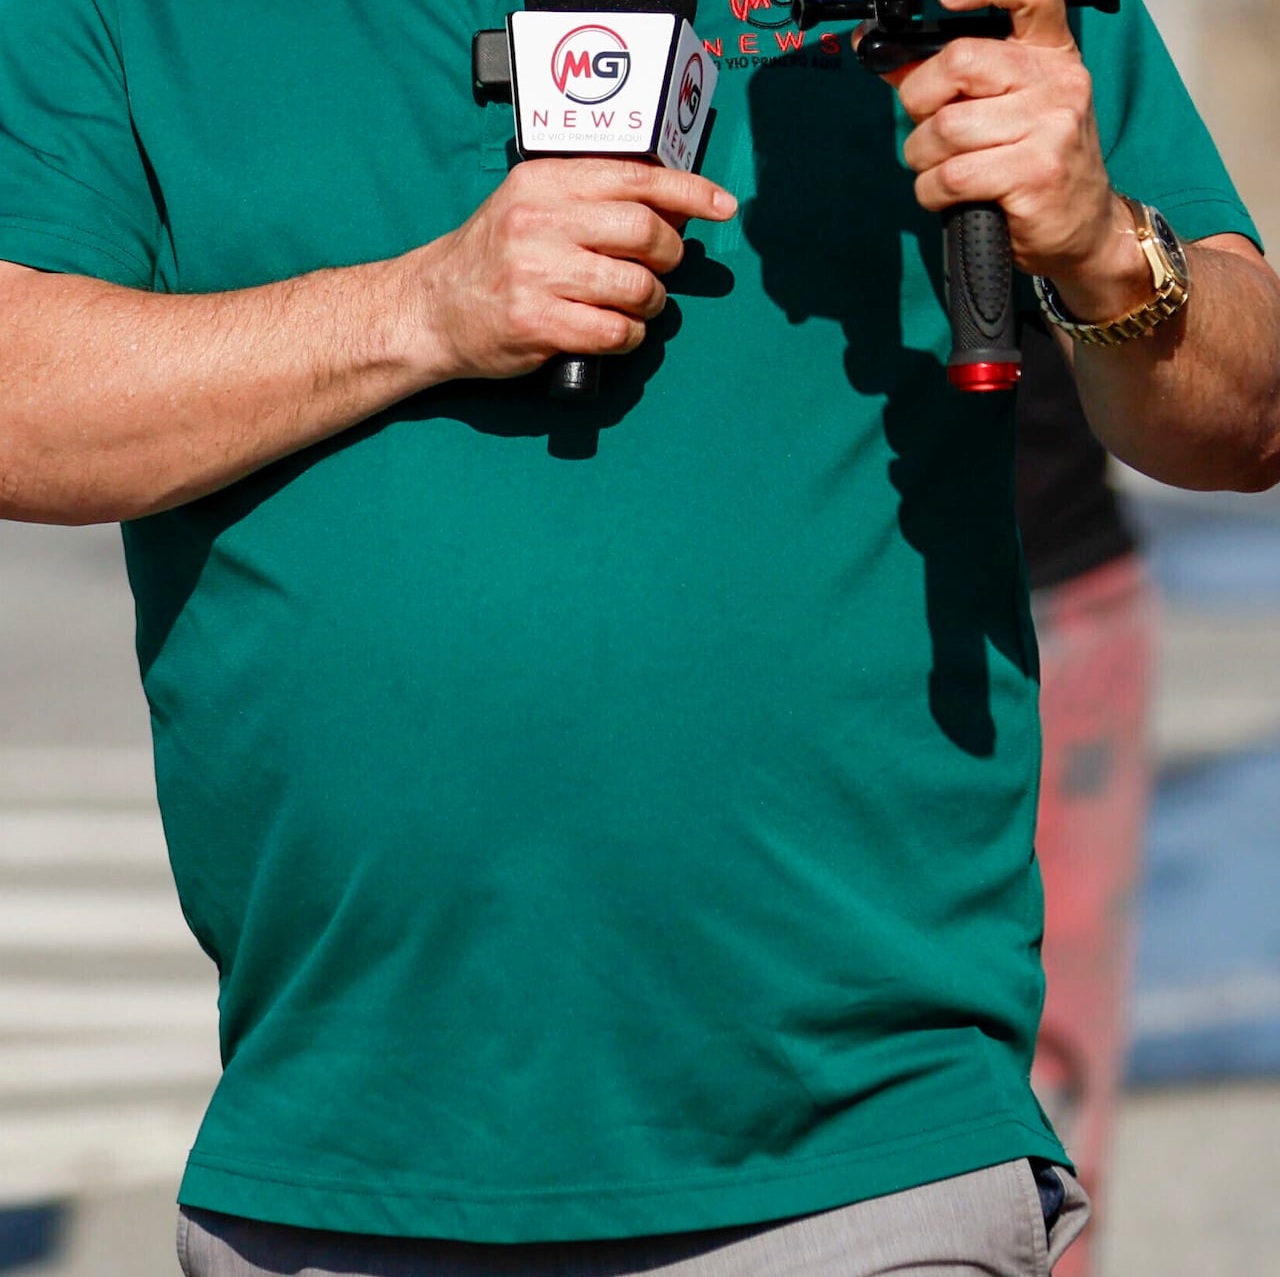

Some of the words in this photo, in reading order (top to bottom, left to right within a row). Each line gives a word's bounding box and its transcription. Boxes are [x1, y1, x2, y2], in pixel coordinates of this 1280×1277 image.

[703, 32, 840, 56] NEWS
[559, 50, 631, 86] MG
[532, 110, 643, 129] NEWS
[531, 132, 546, 141] LO
[568, 132, 615, 142] PRIMERO
[665, 119, 692, 170] NEWS
